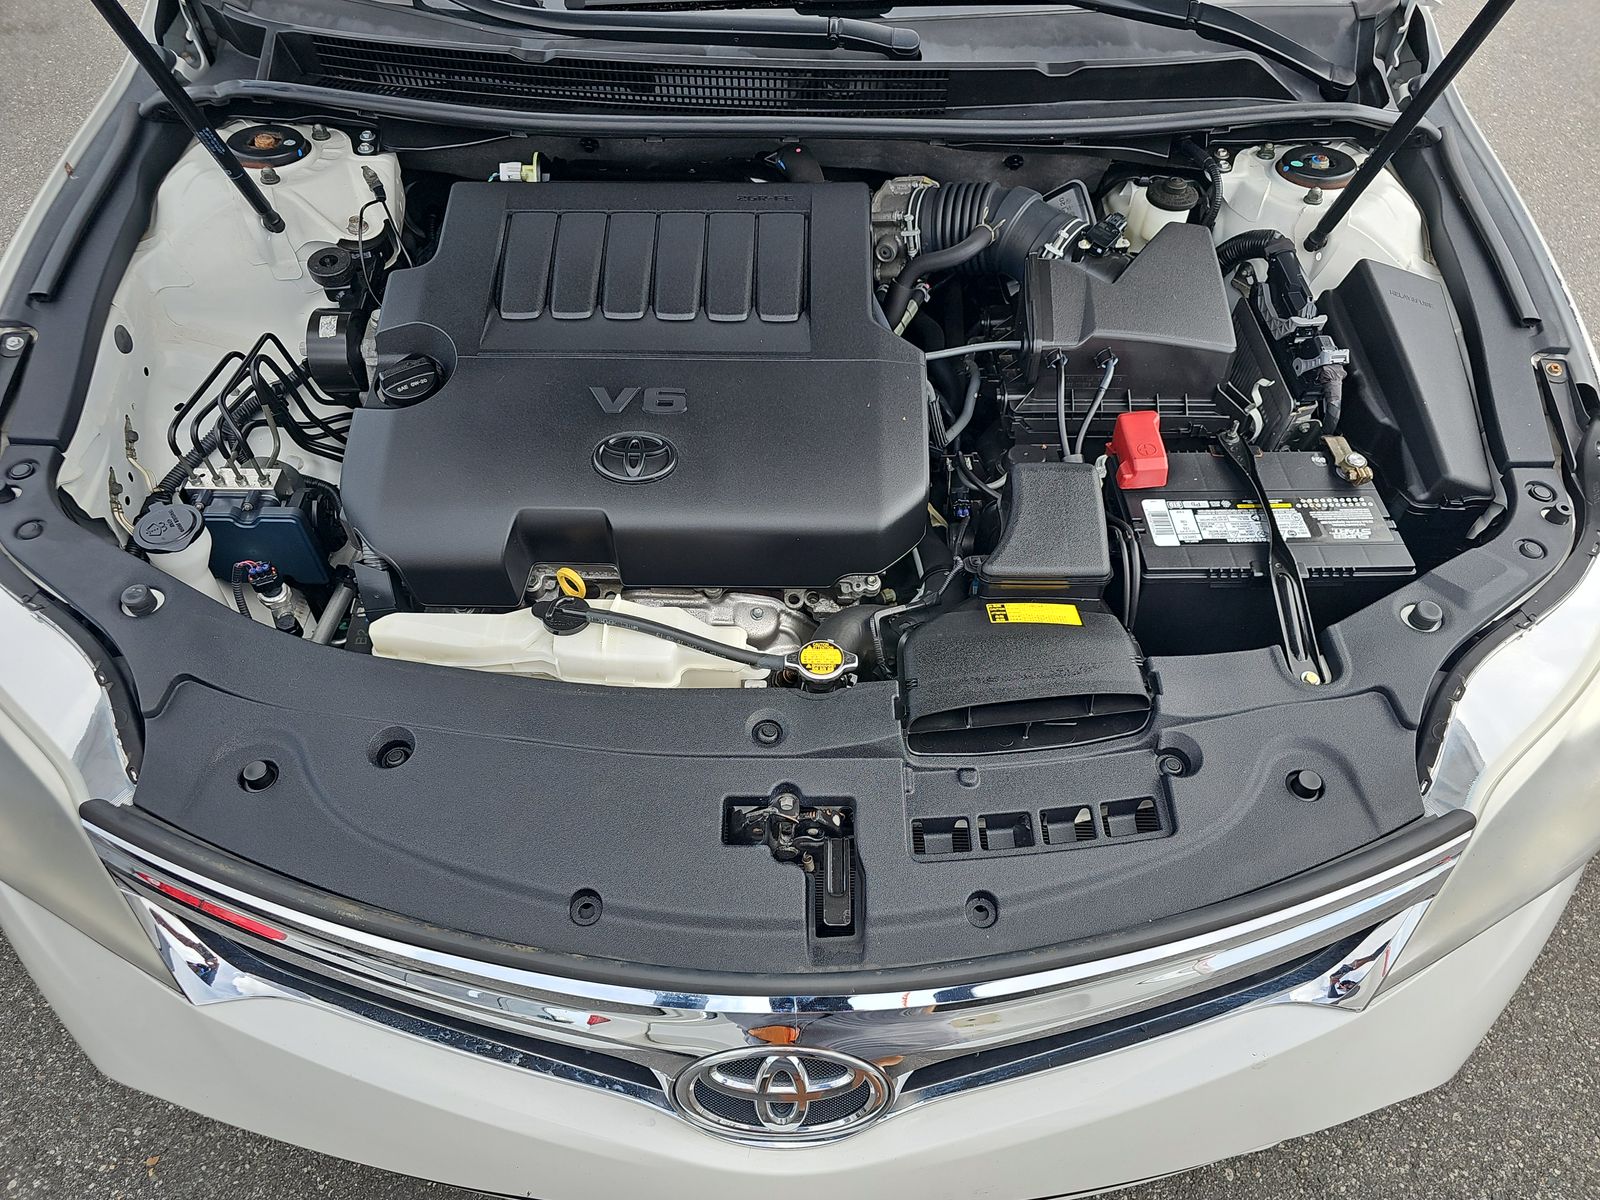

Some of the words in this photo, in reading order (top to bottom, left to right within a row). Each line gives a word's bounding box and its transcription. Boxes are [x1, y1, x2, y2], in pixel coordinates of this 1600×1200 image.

[396, 384, 409, 393] SAE
[410, 378, 428, 387] 0W-20
[589, 386, 688, 415] V6
